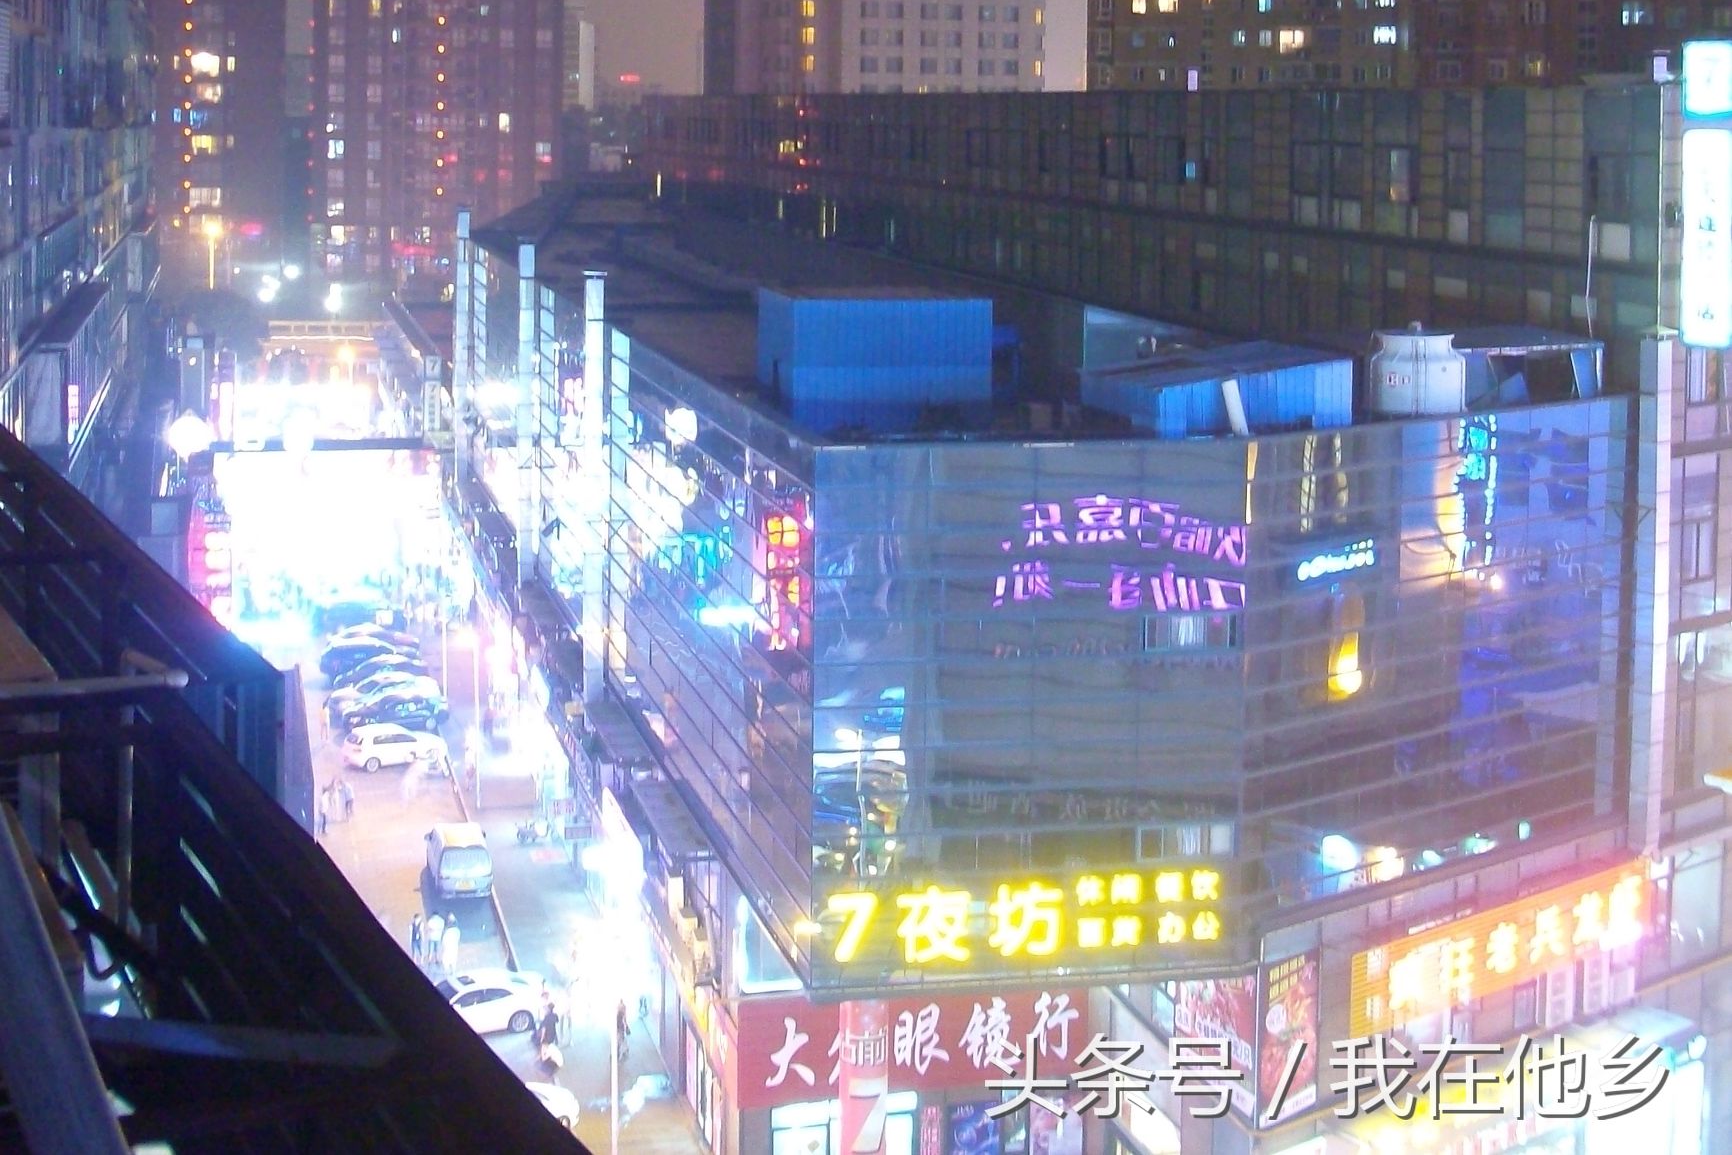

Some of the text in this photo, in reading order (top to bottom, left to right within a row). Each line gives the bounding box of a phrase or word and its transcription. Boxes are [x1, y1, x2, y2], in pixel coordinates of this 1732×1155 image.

[828, 883, 1064, 964] 7夜坊
[764, 990, 1080, 1089] 大眼镜行
